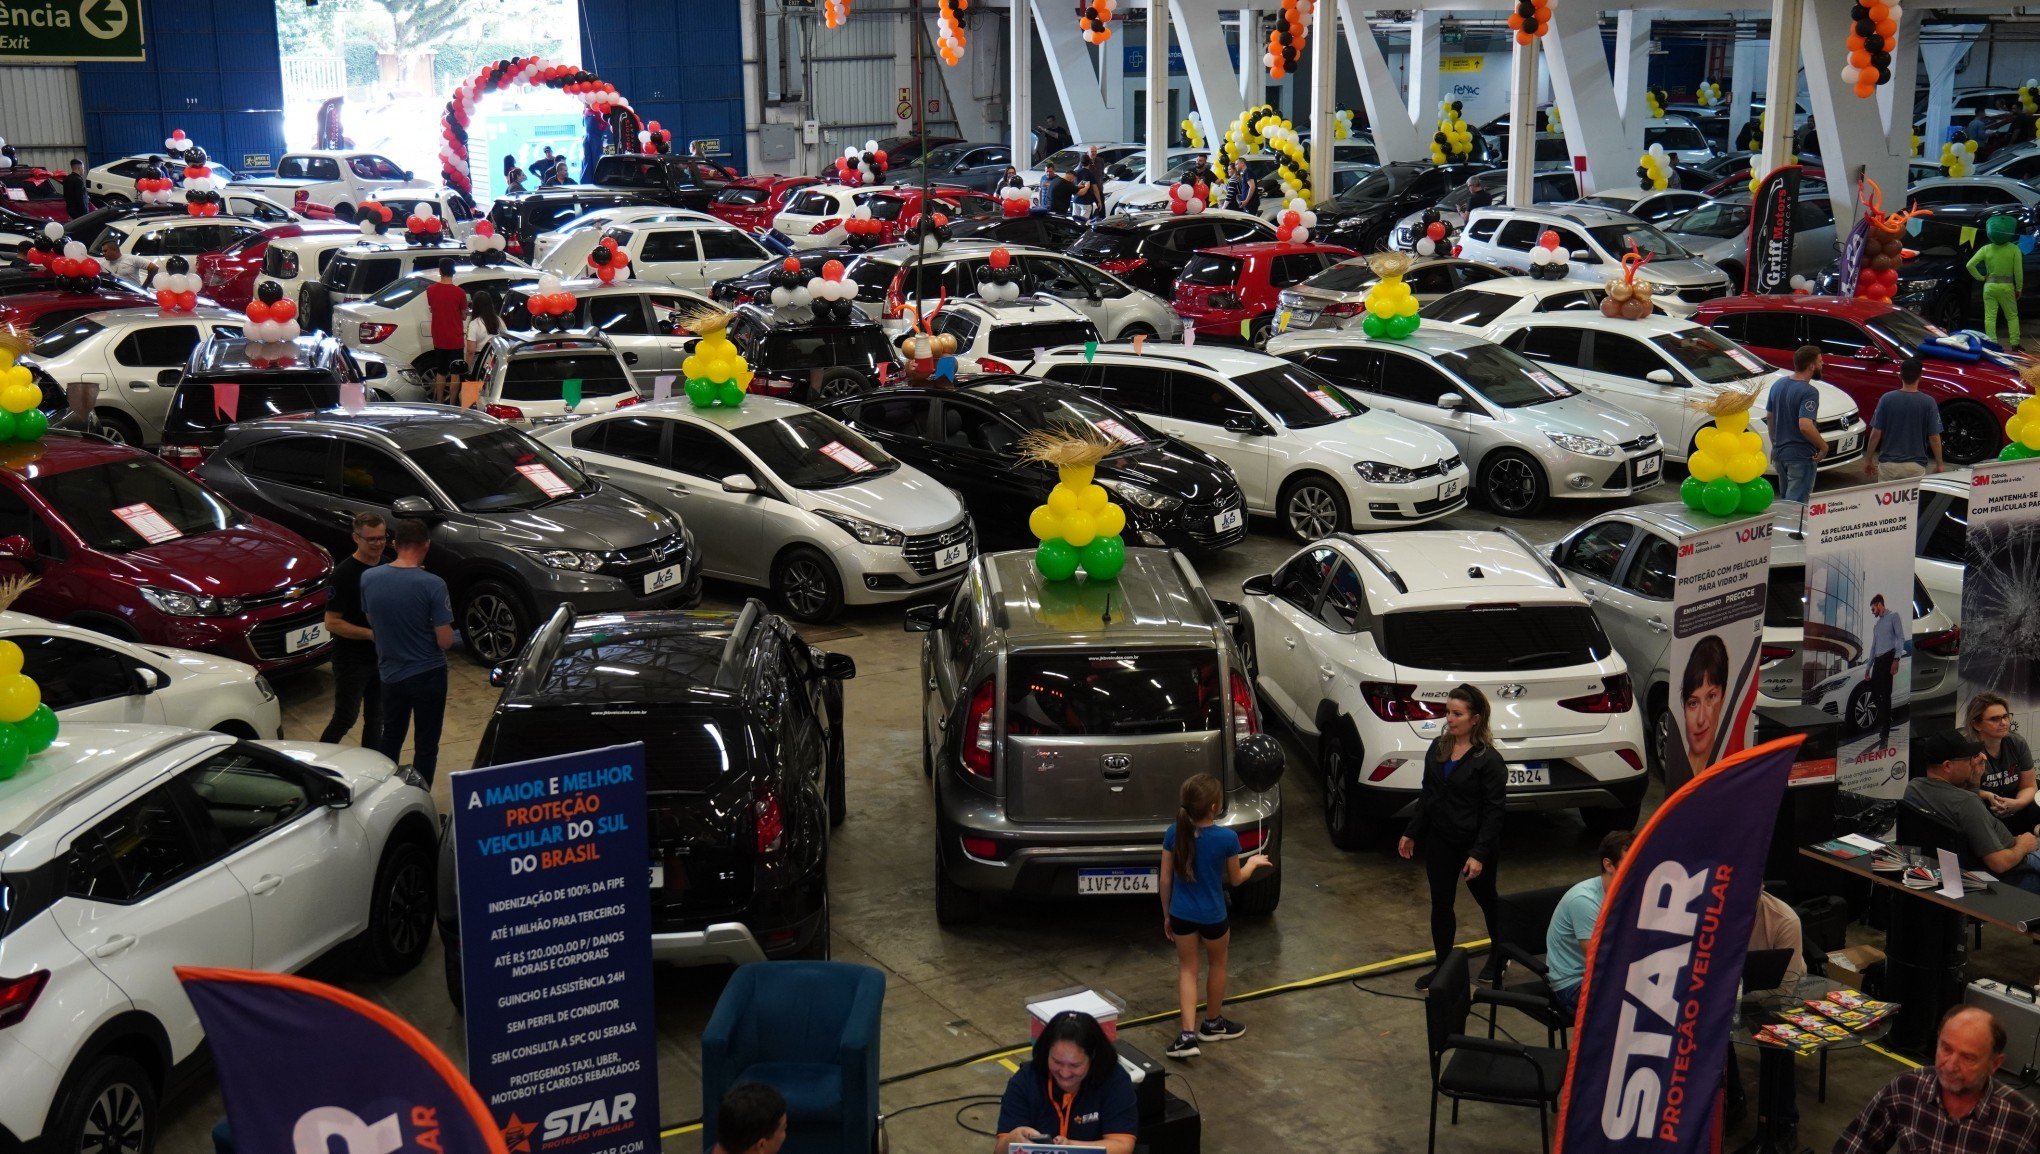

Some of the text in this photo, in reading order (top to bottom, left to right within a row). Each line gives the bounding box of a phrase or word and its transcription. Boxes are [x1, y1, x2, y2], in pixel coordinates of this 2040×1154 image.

[0, 35, 30, 49] Exit
[1767, 189, 1787, 286] Griff Motors
[1781, 196, 1792, 279] MULTIMARCAS
[1972, 475, 1990, 487] 3M
[1809, 503, 1826, 516] 3M
[1875, 488, 1918, 506] VOUKE
[1972, 507, 1989, 515] COM
[1990, 501, 2027, 513] PELÍCULAS
[1988, 491, 2038, 504] MANTENHA-SE
[1736, 523, 1773, 543] VOUKE
[1821, 536, 1833, 544] SÃO
[1834, 531, 1863, 542] GARANTIA
[1874, 524, 1907, 535] QUALIDADE
[1830, 523, 1861, 535] PELÍCULAS
[1862, 521, 1878, 529] PARA
[1879, 517, 1897, 526] VIDRO
[1678, 544, 1694, 557] 3M
[1679, 556, 1768, 586] PROTEÇÃO COM PELÍCULAS
[1698, 572, 1748, 592] PARA VIDRO 3M
[1725, 588, 1755, 604] PRECOCE
[1855, 747, 1897, 765] ATENTO
[467, 765, 634, 810] A MAIOR E MELHOR
[1509, 770, 1541, 783] 3B24
[506, 792, 600, 827] PROTEÇÃO
[478, 814, 628, 856] VEICULAR DO SUL
[511, 843, 600, 875] DO BRASIL
[489, 877, 625, 913] INDENIZAÇÃO DE 100% DA FIPE
[1087, 876, 1149, 891] IVF7C64
[491, 904, 625, 940] ATÉ 1 MILHÃO PARA TERCEIROS
[494, 931, 625, 968] ATÉ R$ 120.000,00 P/ DANOS
[512, 948, 609, 978] MORAIS E CORPORAIS
[498, 971, 626, 1008] GUINCHO E ASSISTÊNCIA 24H
[1601, 860, 1709, 1141] STAR
[1659, 864, 1733, 1143] PROTEÇÃO VEICULAR
[506, 999, 620, 1034] SEM PERFIL DE CONDUTOR
[491, 1021, 637, 1065] SEM CONSULTA A SPC OU SERASA
[491, 1060, 640, 1105] MOTOBOY E CARROS REBAIXADOS
[510, 1064, 570, 1087] PROTEGEMOS
[597, 1052, 622, 1067] UBER,
[543, 1092, 636, 1141] STAR
[541, 1121, 635, 1150] PROTEÇÃO VEICULAR
